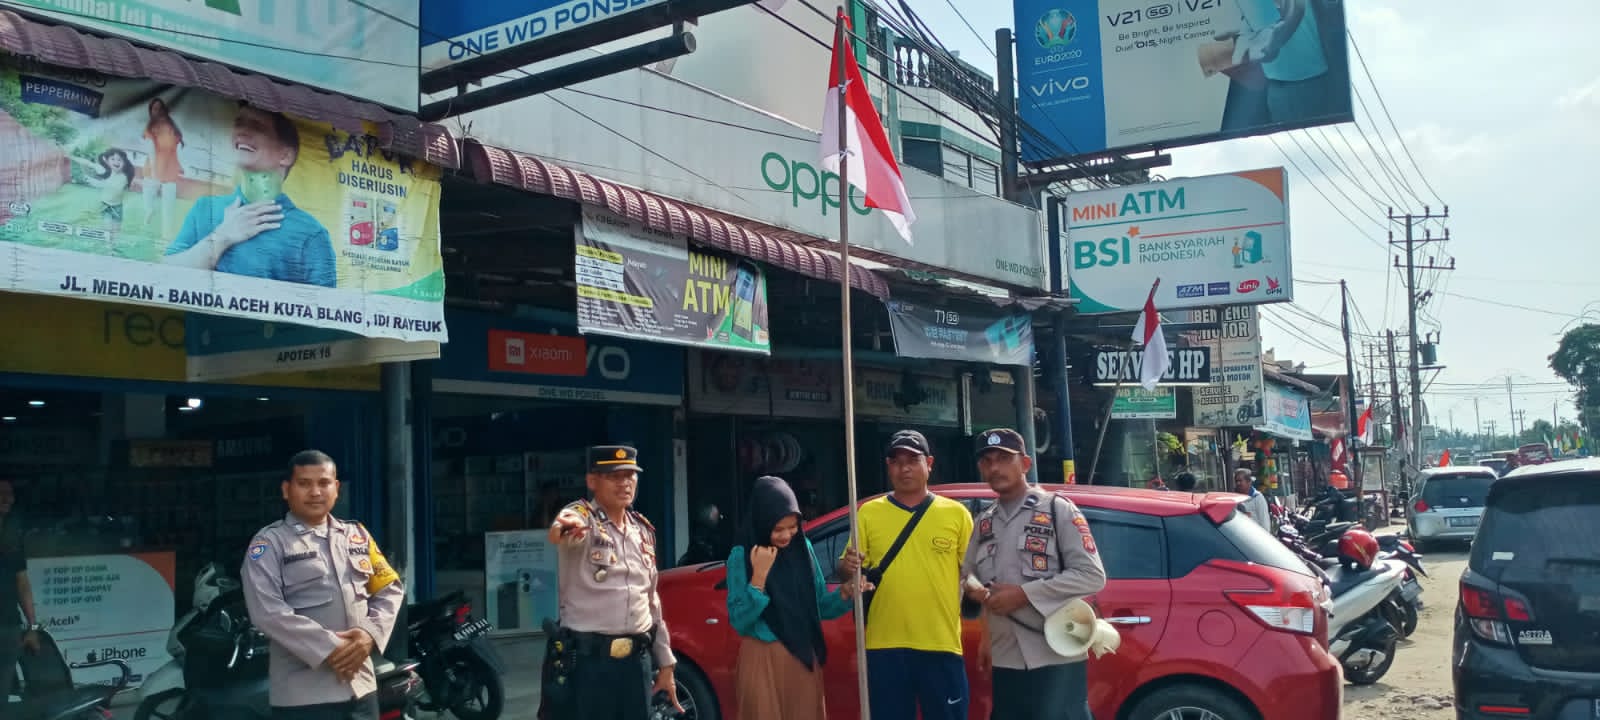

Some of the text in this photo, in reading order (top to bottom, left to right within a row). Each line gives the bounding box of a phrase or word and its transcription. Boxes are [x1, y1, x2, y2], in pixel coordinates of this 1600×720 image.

[1106, 9, 1141, 27] V21
[447, 36, 499, 61] ONE
[505, 16, 547, 45] WD
[1118, 17, 1210, 41] Be Bright, Be Inspired
[1115, 43, 1134, 53] Dual
[1184, 29, 1216, 40] Camera
[25, 81, 98, 107] PEPPERMINT
[1030, 75, 1089, 97] vivo
[351, 159, 393, 181] HARUS
[338, 172, 407, 198] DISERIUSIN
[1072, 186, 1185, 222] MINI ATM
[1074, 236, 1131, 270] BSI
[1139, 235, 1225, 253] BANK SYARIAH
[688, 252, 727, 281] MINI
[995, 257, 1009, 272] ONE
[1139, 250, 1205, 264] INDONESIA
[60, 275, 87, 293] JL.
[93, 278, 154, 301] MEDAN
[169, 289, 224, 309] BANDA
[228, 297, 269, 314] ACEH
[274, 301, 313, 319] KUTA
[317, 307, 362, 324] BLANG
[374, 313, 390, 328] IDI
[393, 316, 442, 333] RAYEUK
[682, 278, 731, 316] ATM
[1193, 305, 1250, 323] BENENG
[276, 349, 317, 363] APOTEK
[1096, 350, 1205, 380] SERVE HP
[1024, 525, 1054, 537] POLRI
[53, 567, 68, 575] TOP
[53, 576, 69, 585] TOP
[71, 576, 83, 584] UP
[53, 587, 69, 595] TOP
[53, 597, 69, 605] TOP
[1519, 629, 1552, 640] ASTRA
[101, 647, 147, 660] iPhone
